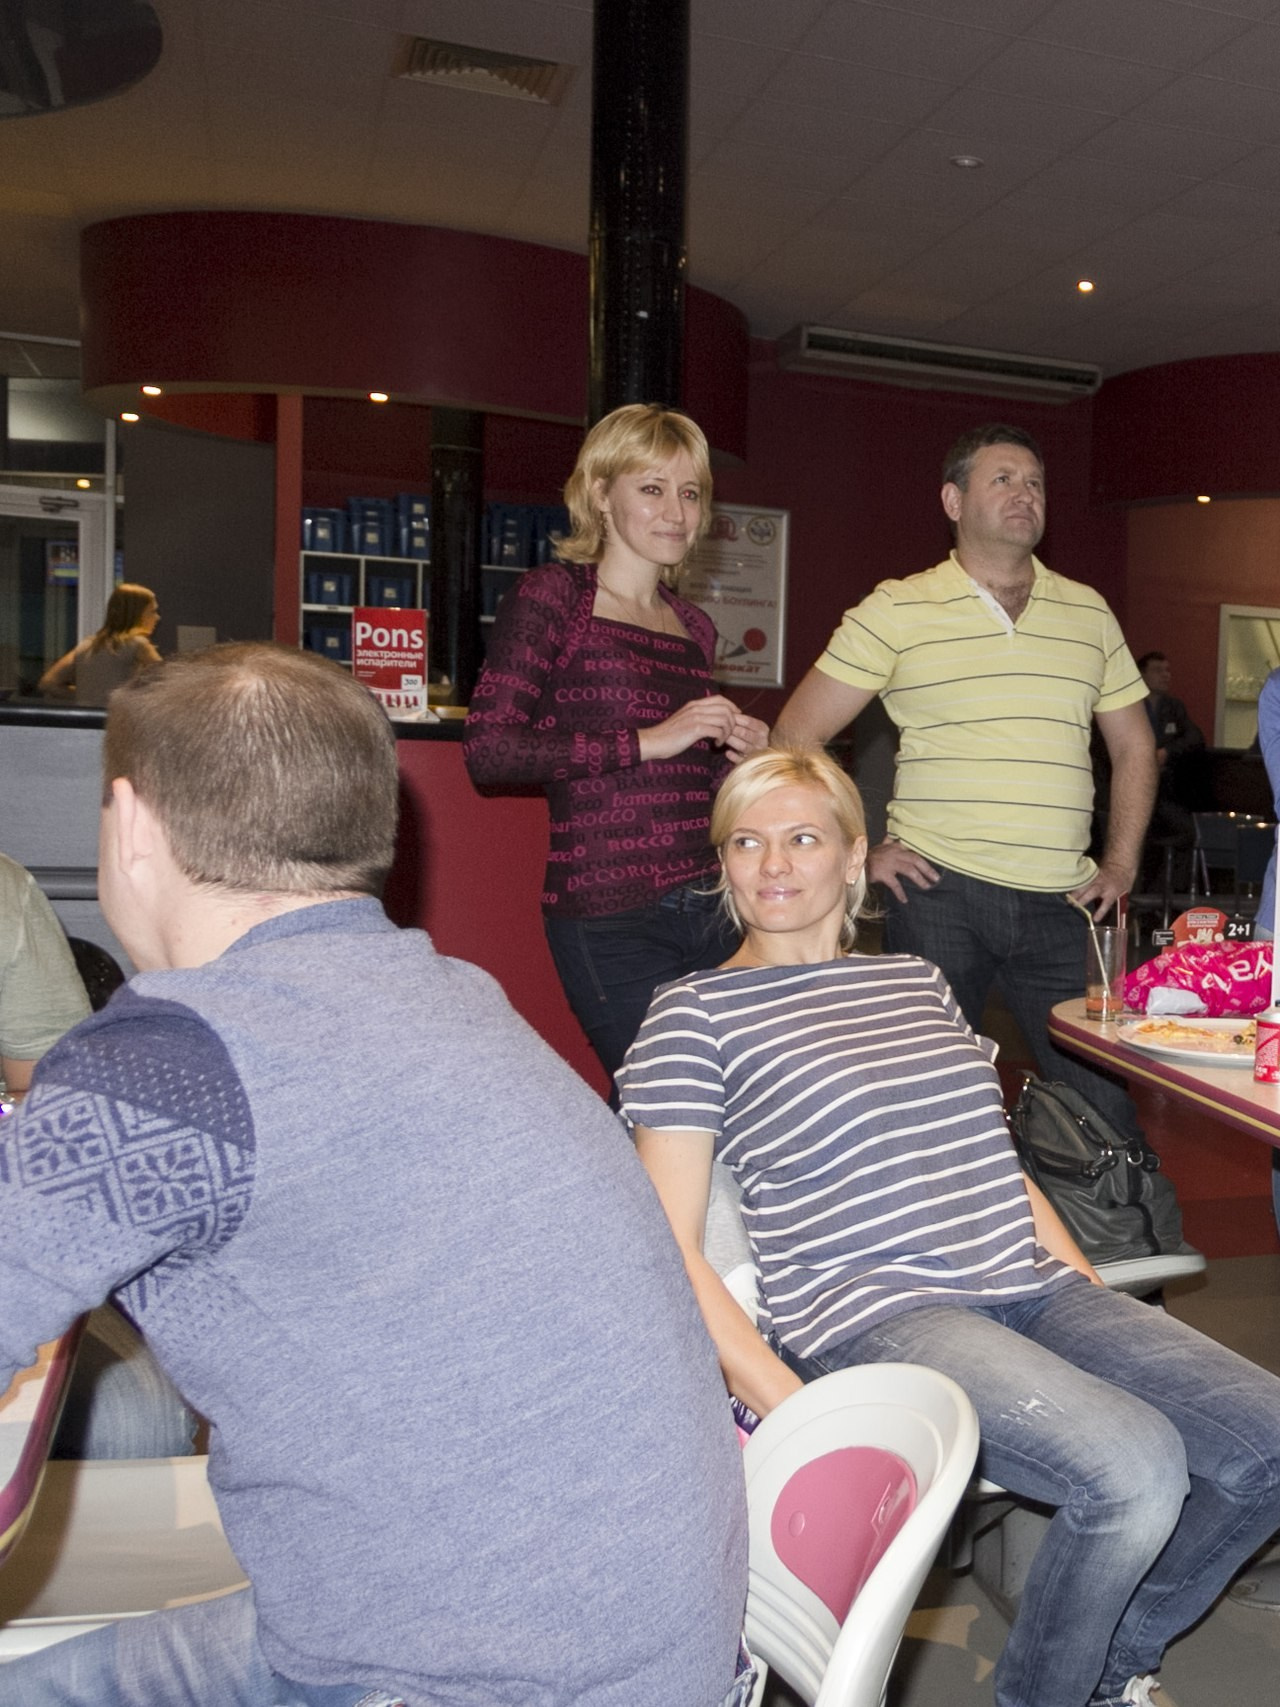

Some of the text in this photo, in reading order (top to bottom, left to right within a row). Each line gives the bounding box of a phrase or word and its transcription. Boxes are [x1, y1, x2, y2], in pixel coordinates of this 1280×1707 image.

[355, 621, 424, 649] Pons
[356, 648, 424, 660] электронные
[356, 658, 417, 668] испарители
[584, 659, 652, 676] ROCCO
[607, 833, 674, 851] ROCCO
[1228, 923, 1251, 937] 2+1
